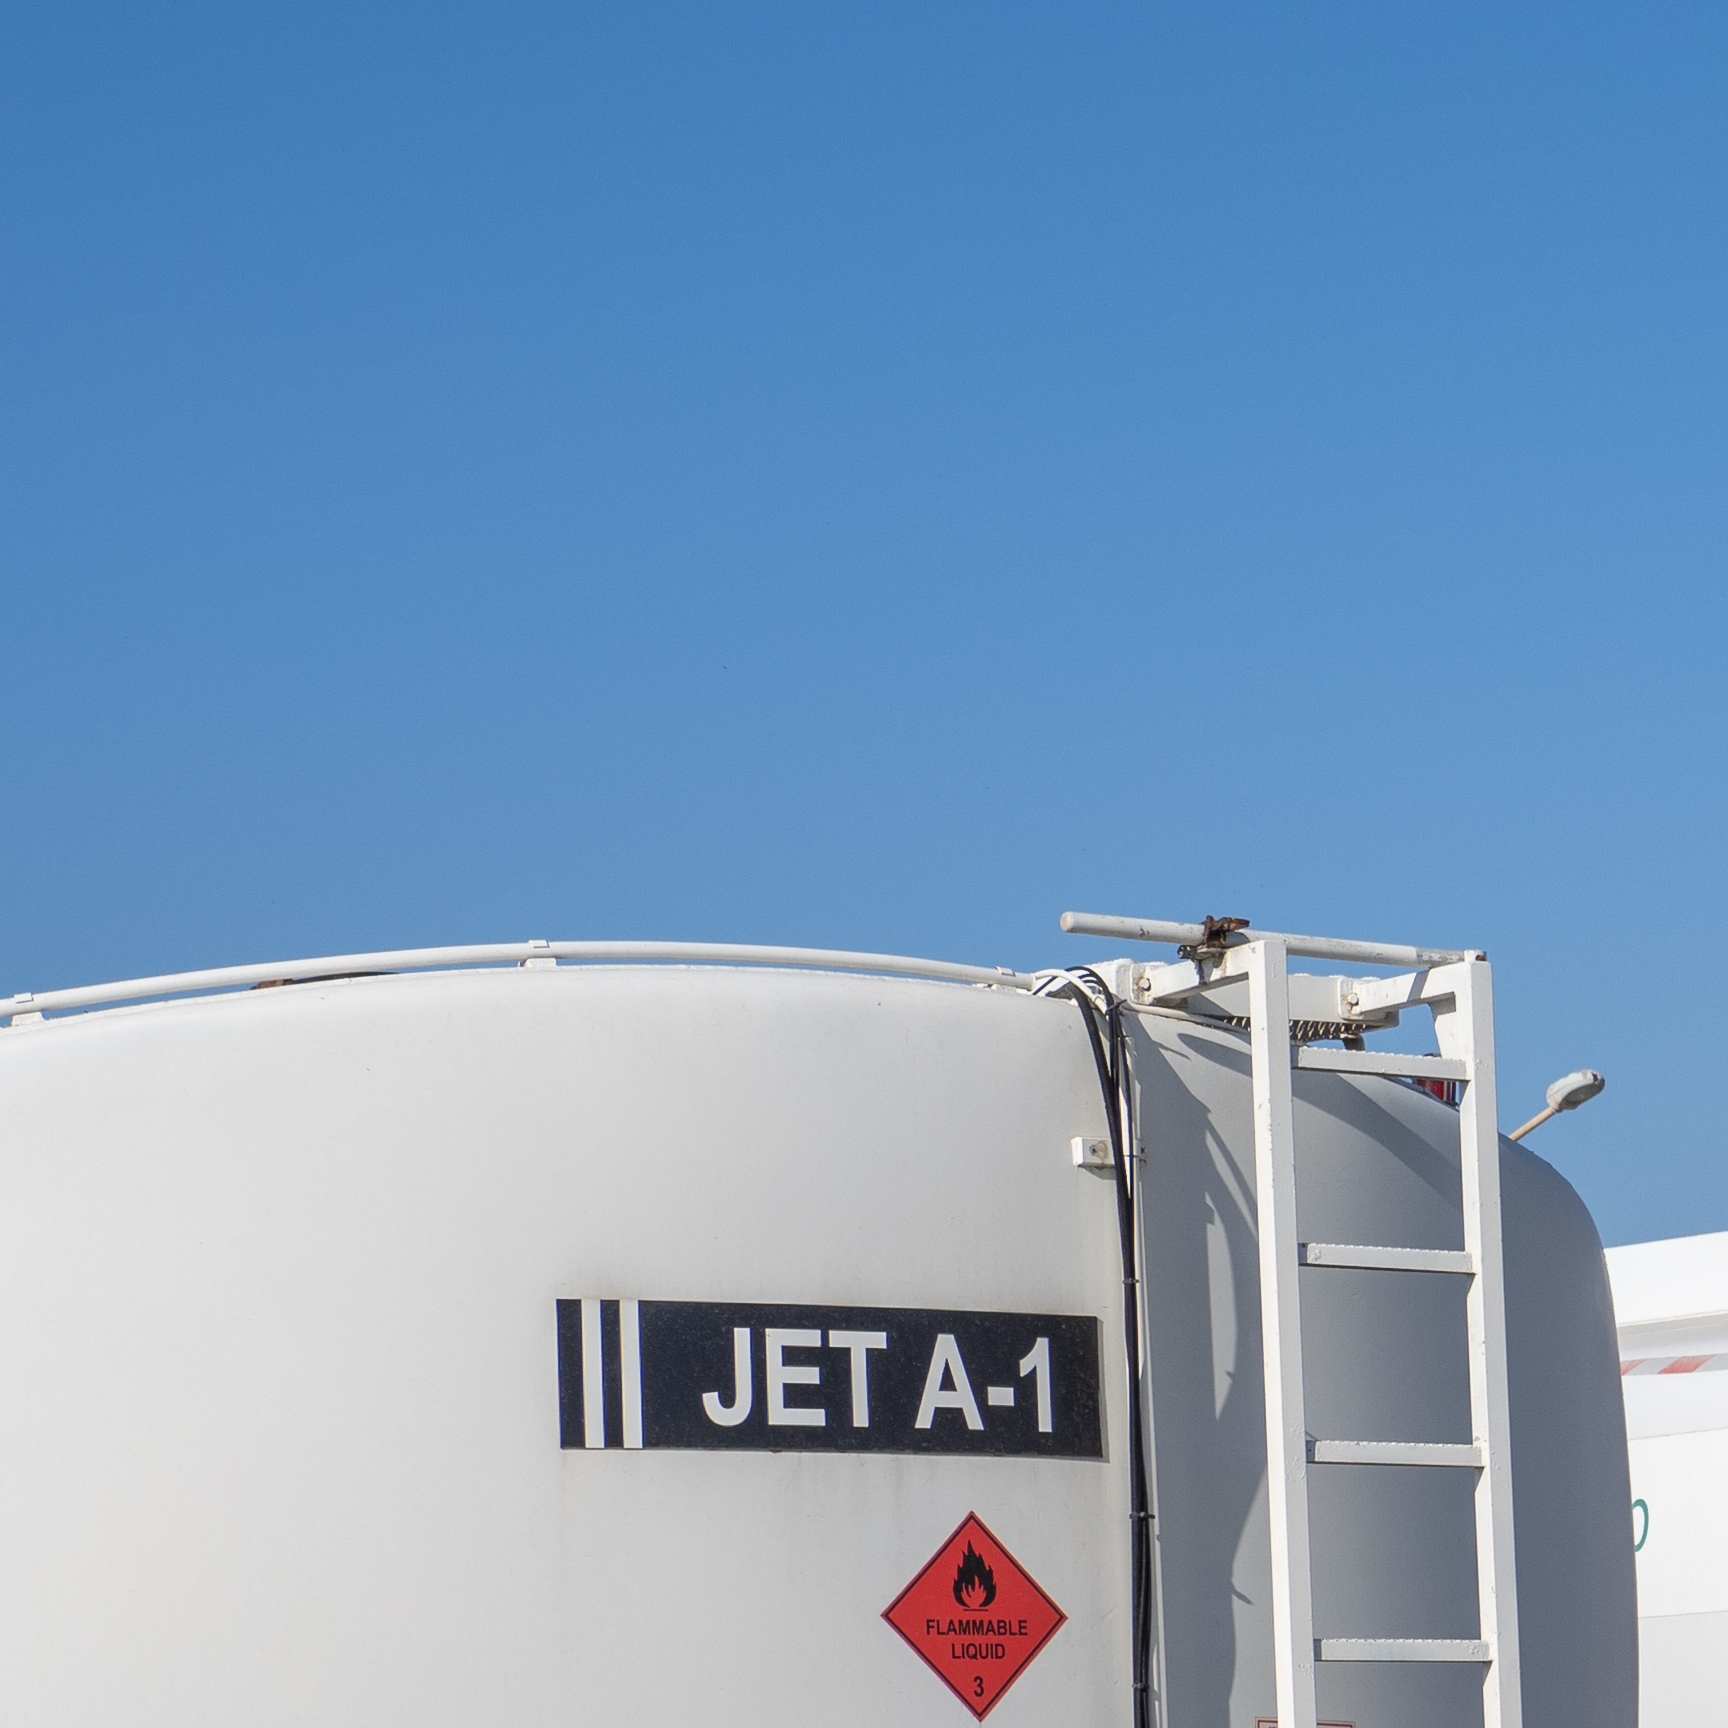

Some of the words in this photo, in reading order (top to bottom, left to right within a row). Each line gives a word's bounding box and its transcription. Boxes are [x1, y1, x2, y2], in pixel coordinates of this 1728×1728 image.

[702, 1327, 888, 1428] JET
[914, 1333, 1053, 1433] A-1
[925, 1618, 1029, 1637] FLAMMABLE
[951, 1642, 1006, 1661] LIQUID
[973, 1676, 985, 1698] 3
